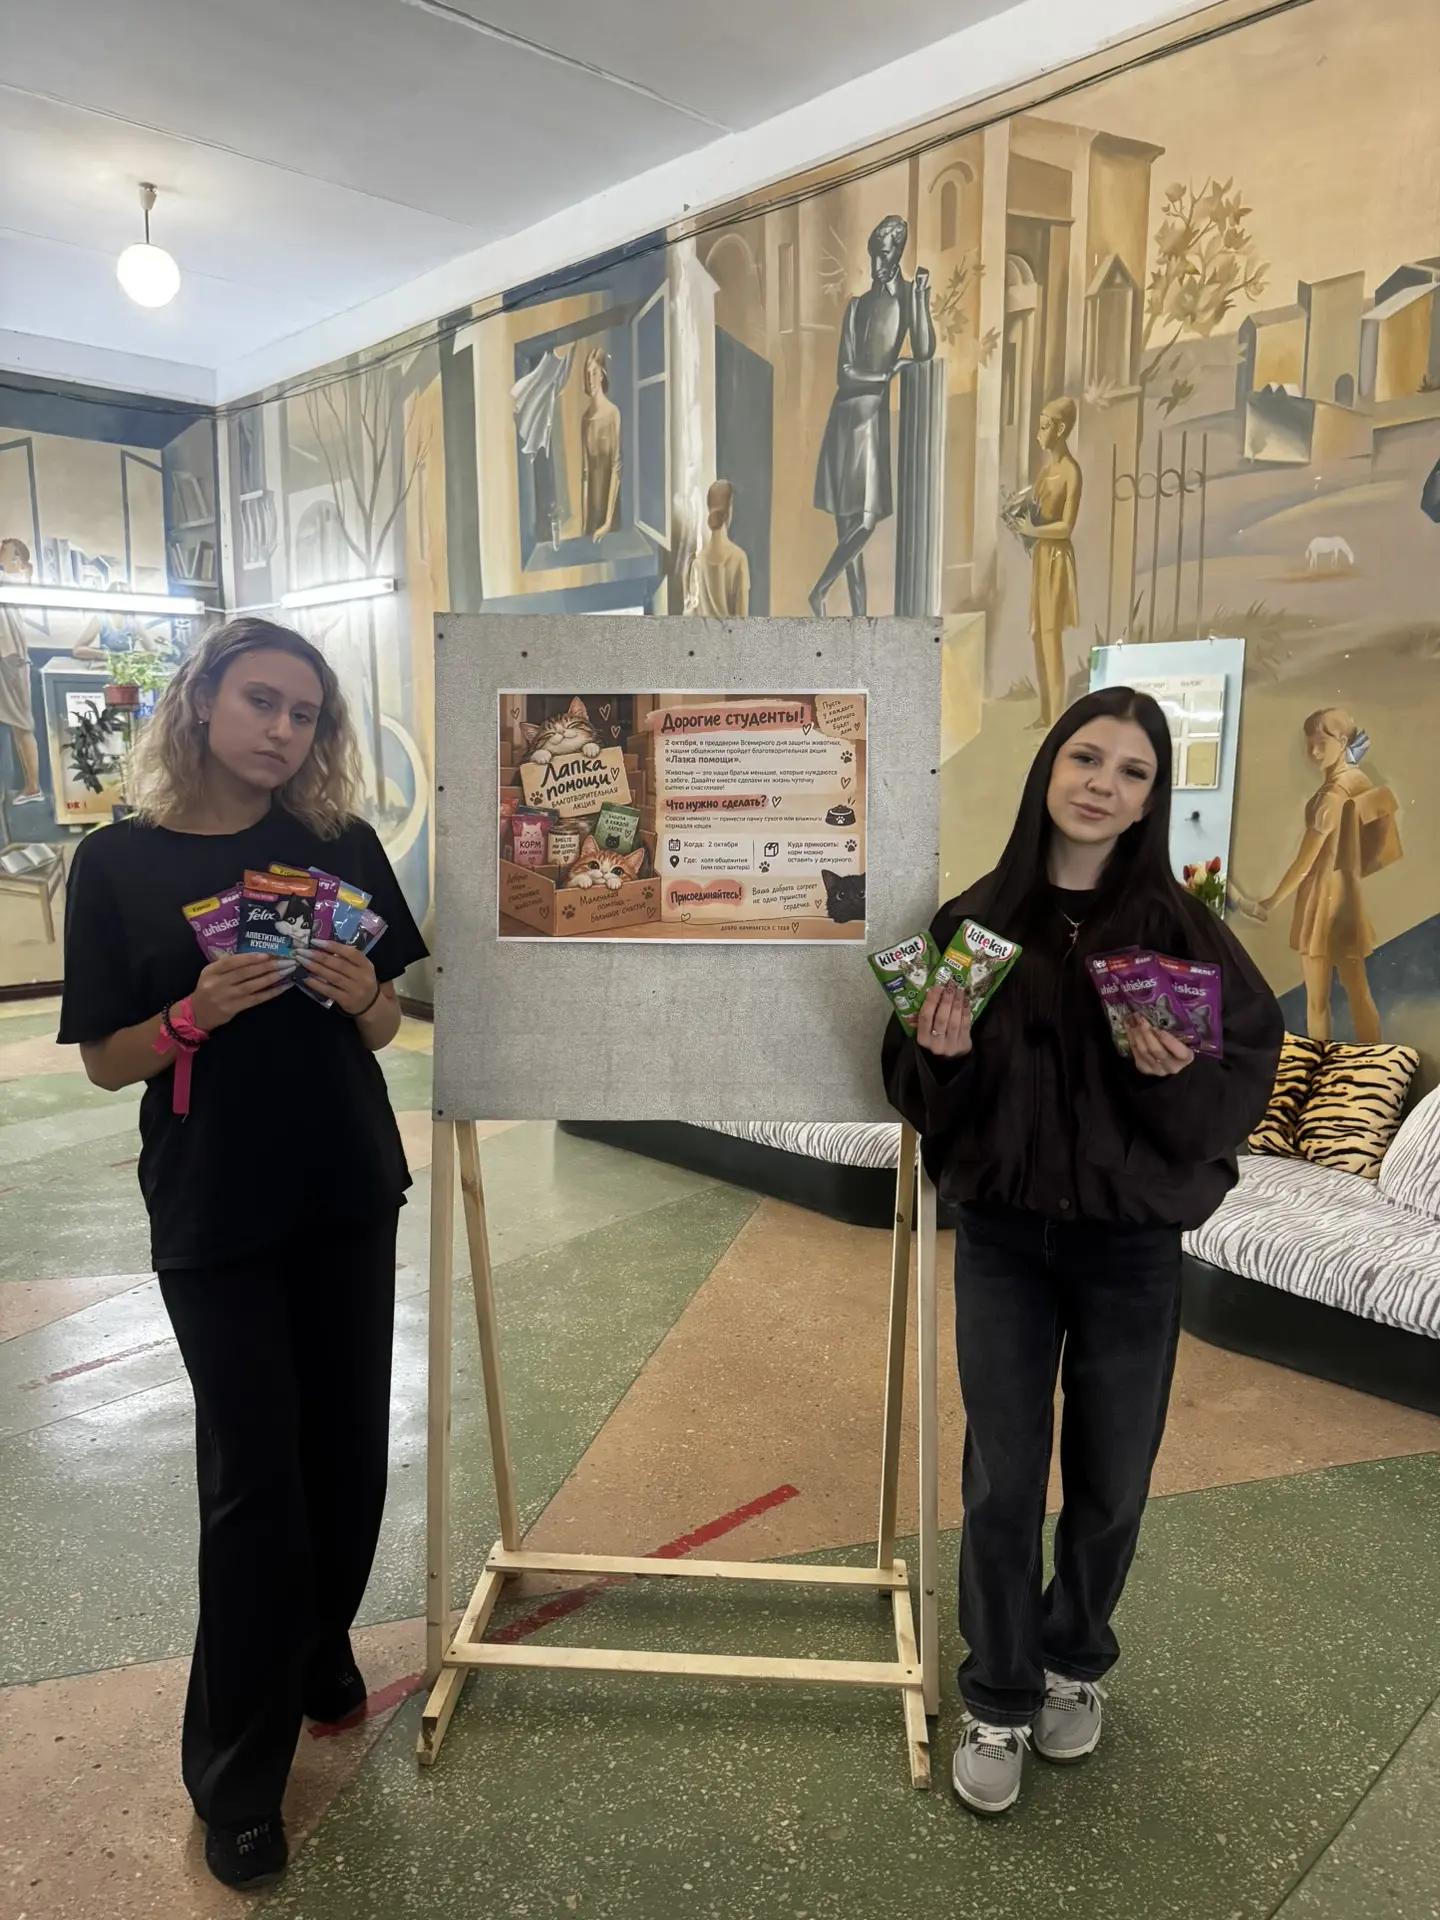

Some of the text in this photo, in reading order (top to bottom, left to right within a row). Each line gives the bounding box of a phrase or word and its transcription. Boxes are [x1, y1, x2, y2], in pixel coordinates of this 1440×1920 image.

[661, 706, 805, 733] Дорогие студенты!
[740, 739, 775, 747] Всемирного
[752, 747, 808, 755] благотворительная
[698, 756, 741, 764] помощи».
[540, 759, 608, 788] Лапка
[546, 773, 612, 801] помощи
[551, 786, 618, 809] БЛАГОТВОРИТЕЛЬНАЯ
[572, 800, 596, 810] АКЦИЯ
[665, 796, 767, 812] Что нужно сделать?
[519, 840, 541, 849] КОРМ
[670, 886, 742, 906] Присоединяйтесь!
[752, 883, 818, 896] Ваша доброта согреет
[246, 907, 276, 923] felix
[202, 917, 240, 937] whiska
[244, 930, 287, 944] АППЕТИТНЫЕ
[250, 939, 280, 951] КУСОЧКИ
[967, 928, 1008, 957] kitekat
[878, 941, 921, 967] kitekat
[1172, 981, 1207, 997] iskas
